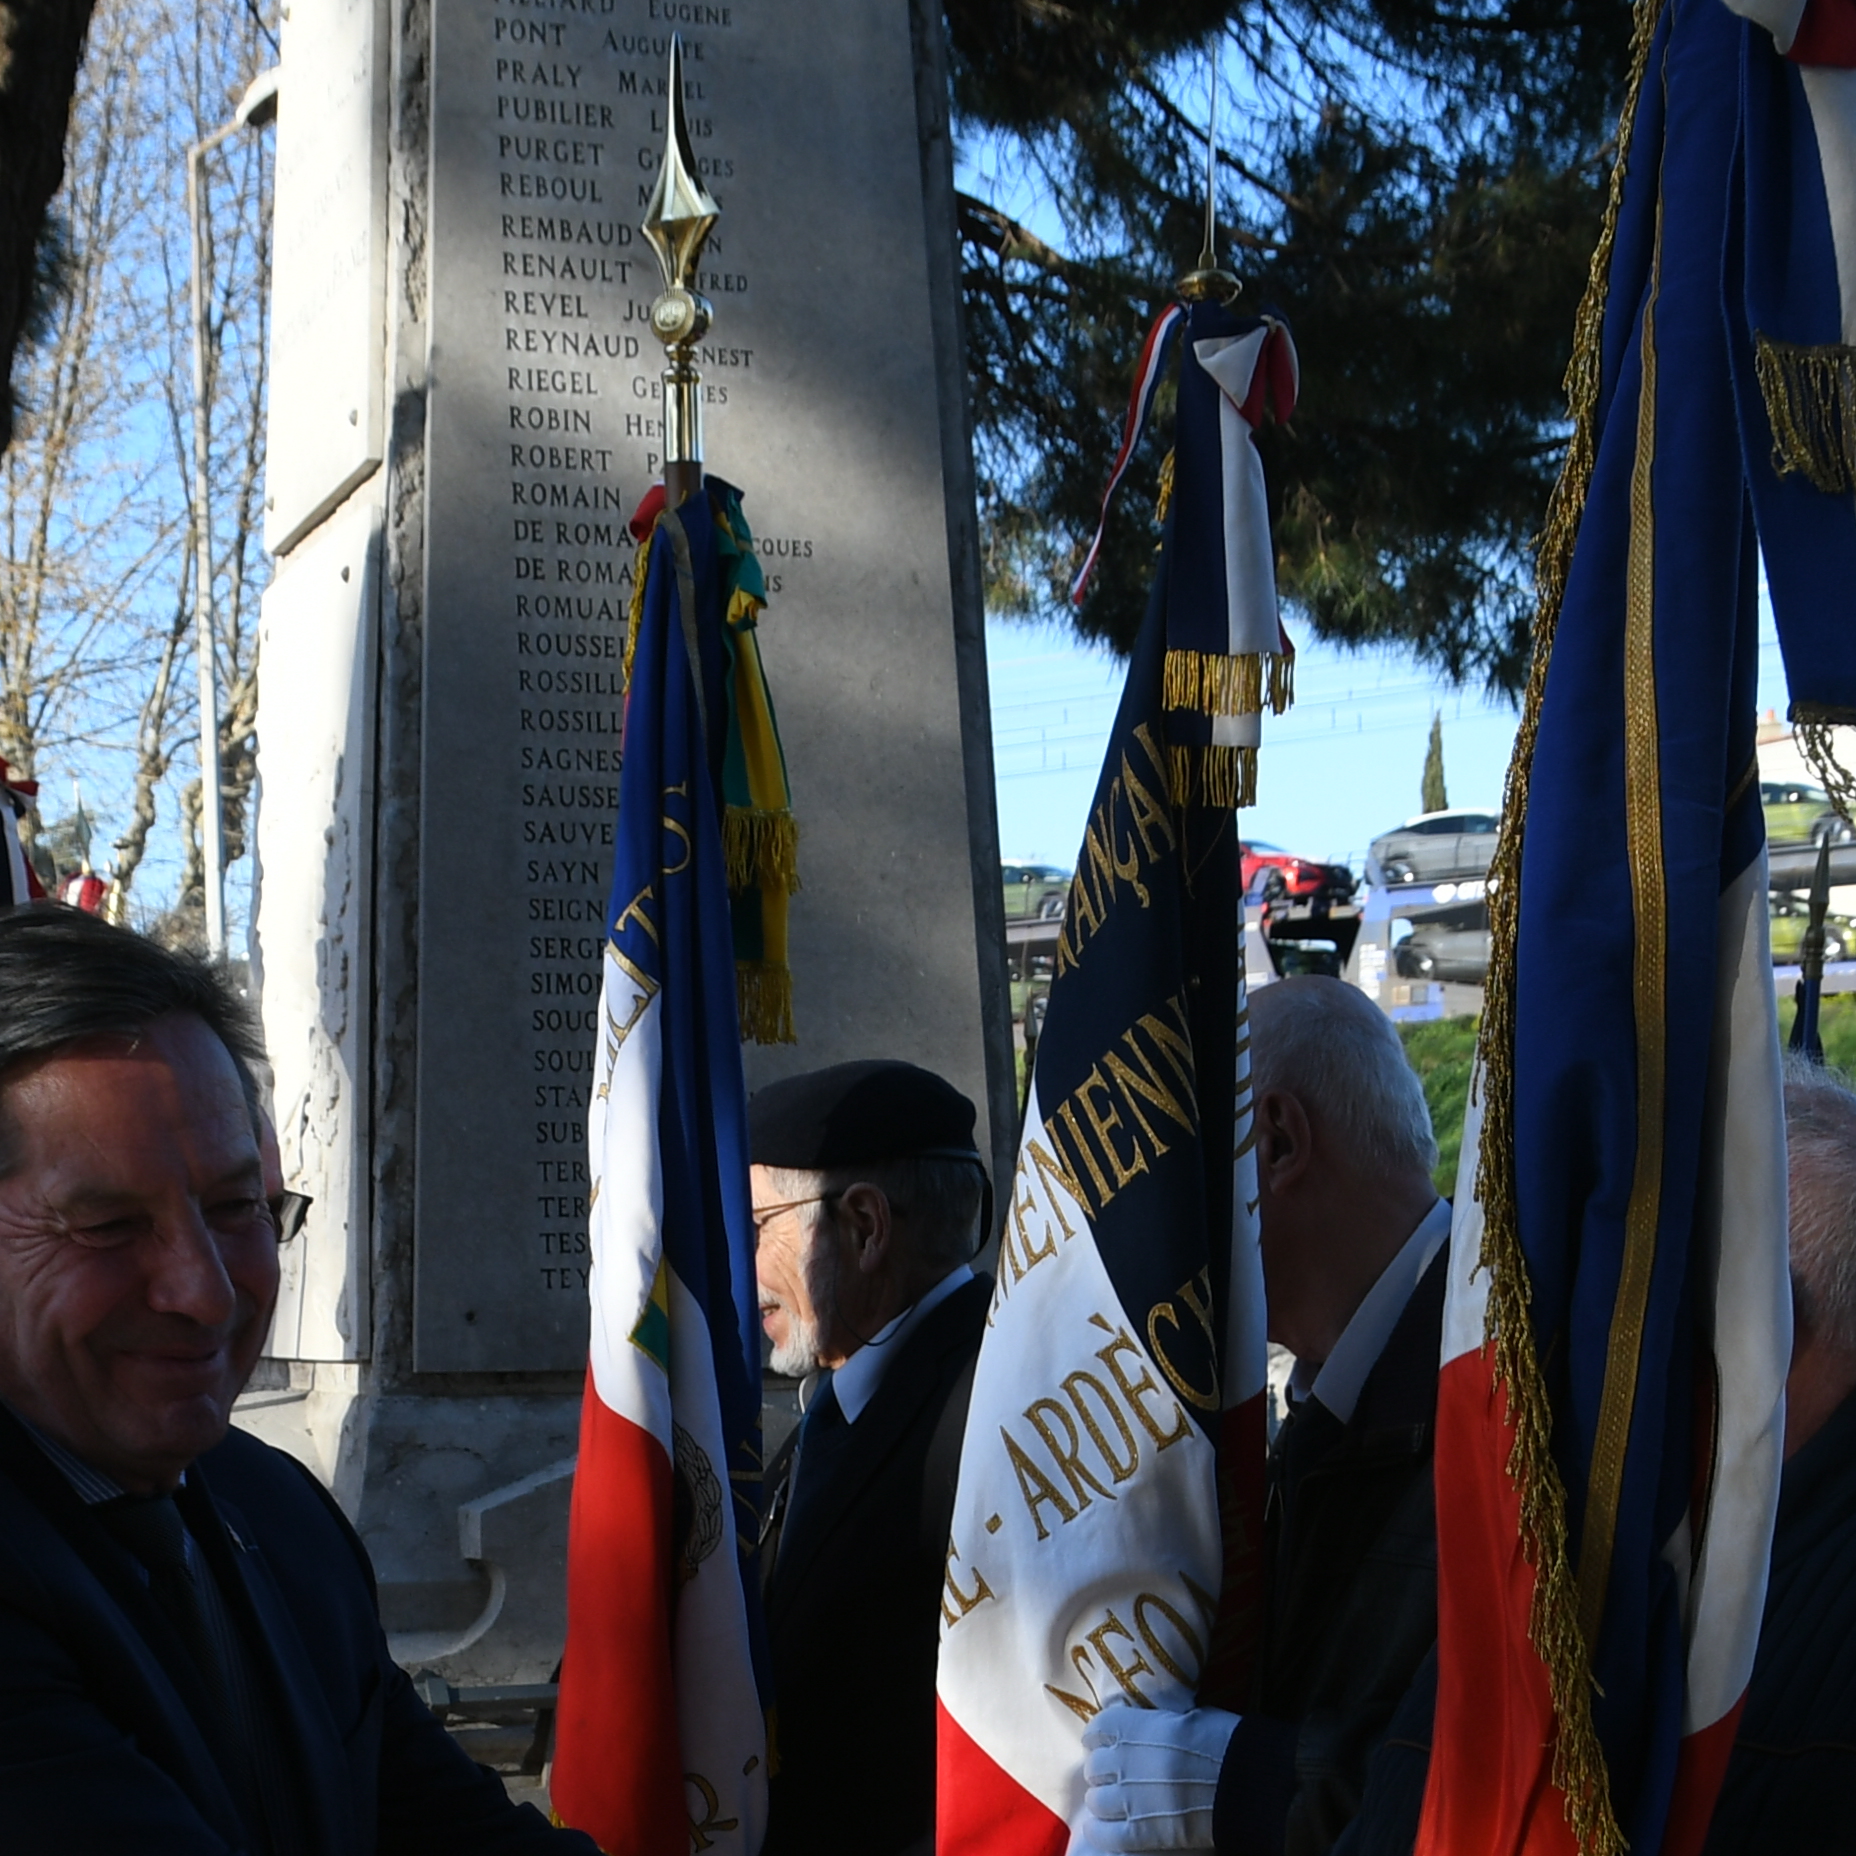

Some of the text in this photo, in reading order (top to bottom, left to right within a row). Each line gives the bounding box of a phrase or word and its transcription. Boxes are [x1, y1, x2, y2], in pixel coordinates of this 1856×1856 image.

[494, 18, 704, 60] PONT AUGUTE
[497, 58, 706, 100] PRALY MAREL
[497, 96, 713, 138] PUBILIER LUIS
[499, 135, 604, 167] PURGET
[500, 172, 603, 203] REBOUL
[501, 214, 632, 246] REMBAUD
[503, 251, 633, 284] RENAULT
[505, 290, 588, 319] REVEL
[506, 328, 640, 359] REYNAUD
[508, 367, 598, 395] RIEGEL
[509, 405, 591, 434] ROBIN
[510, 444, 613, 472] ROBERT
[512, 482, 621, 511] ROMAIN
[514, 520, 544, 543] DE
[515, 557, 544, 580] DE
[527, 860, 599, 884] SAYN
